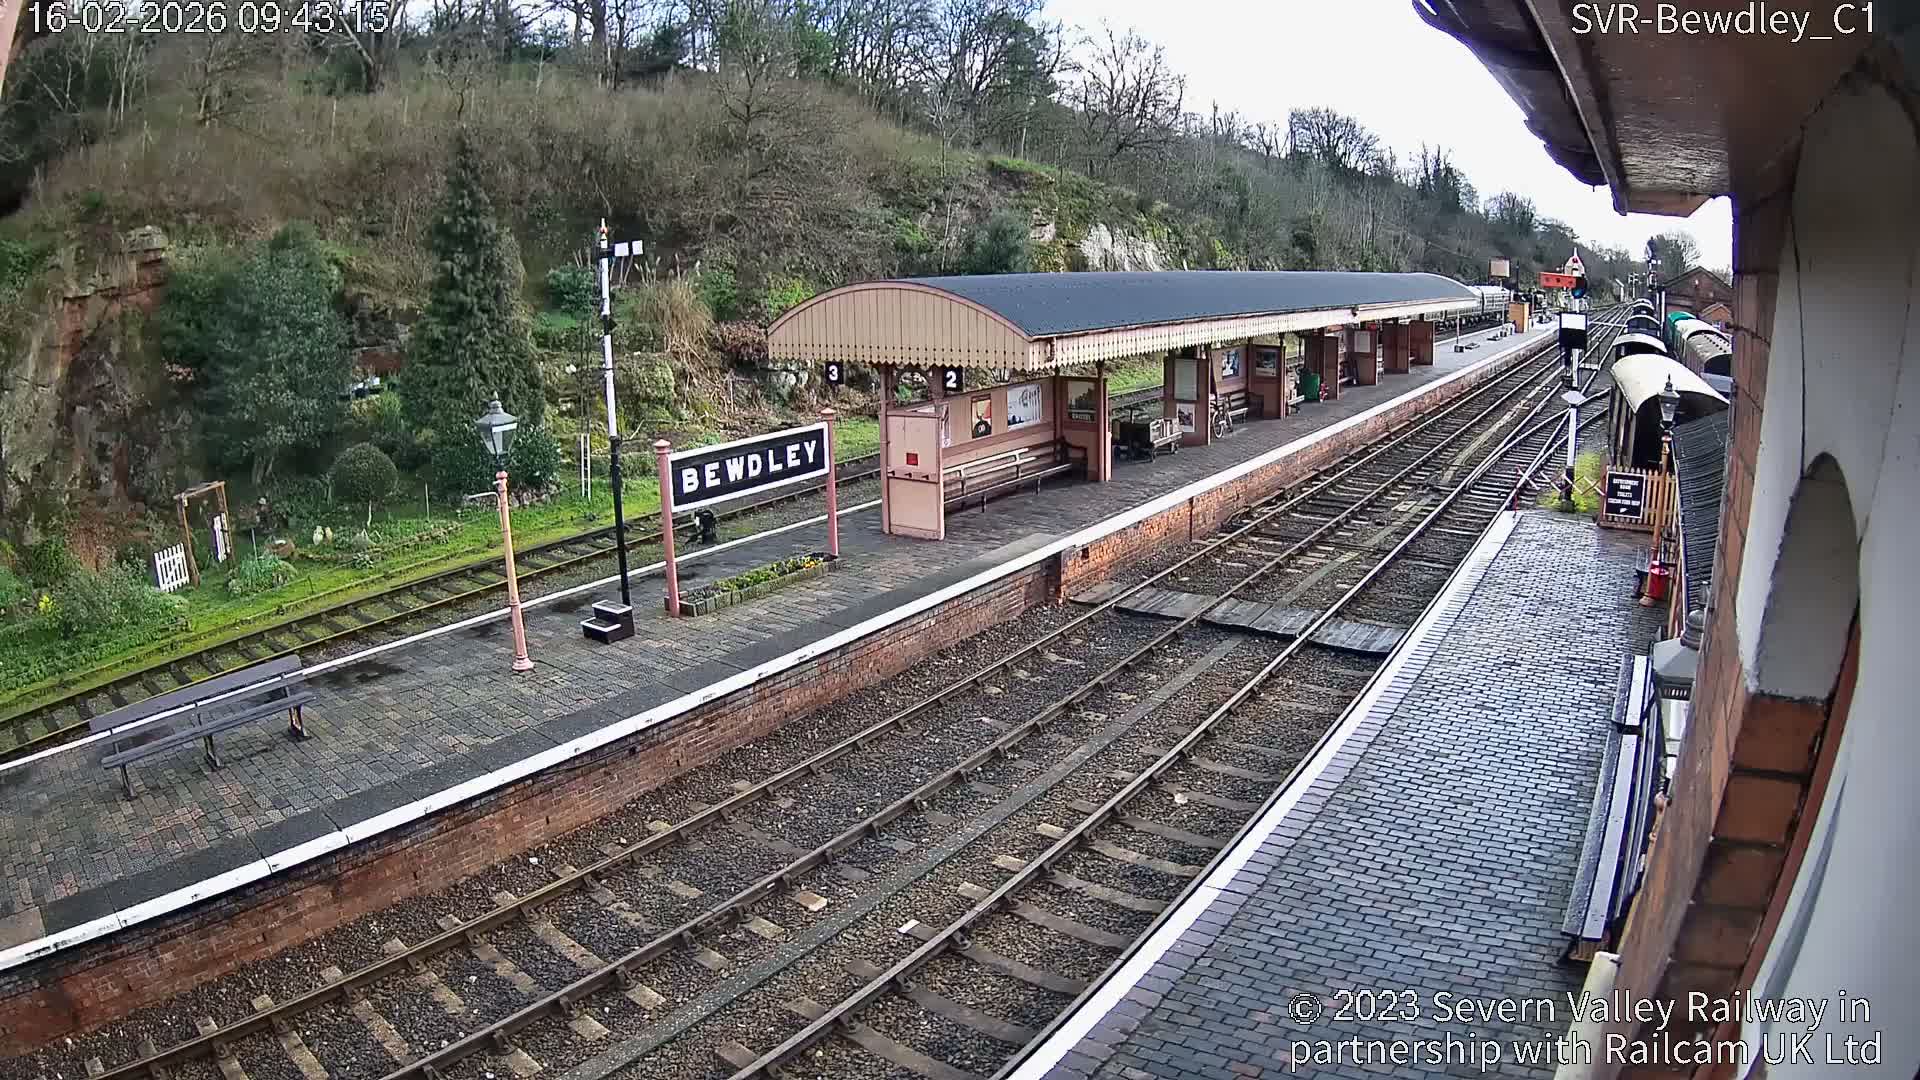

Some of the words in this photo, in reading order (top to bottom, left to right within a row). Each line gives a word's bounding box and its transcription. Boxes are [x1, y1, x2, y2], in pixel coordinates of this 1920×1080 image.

[828, 364, 839, 381] 3
[945, 370, 957, 389] 2
[681, 439, 817, 494] BEWDLEY
